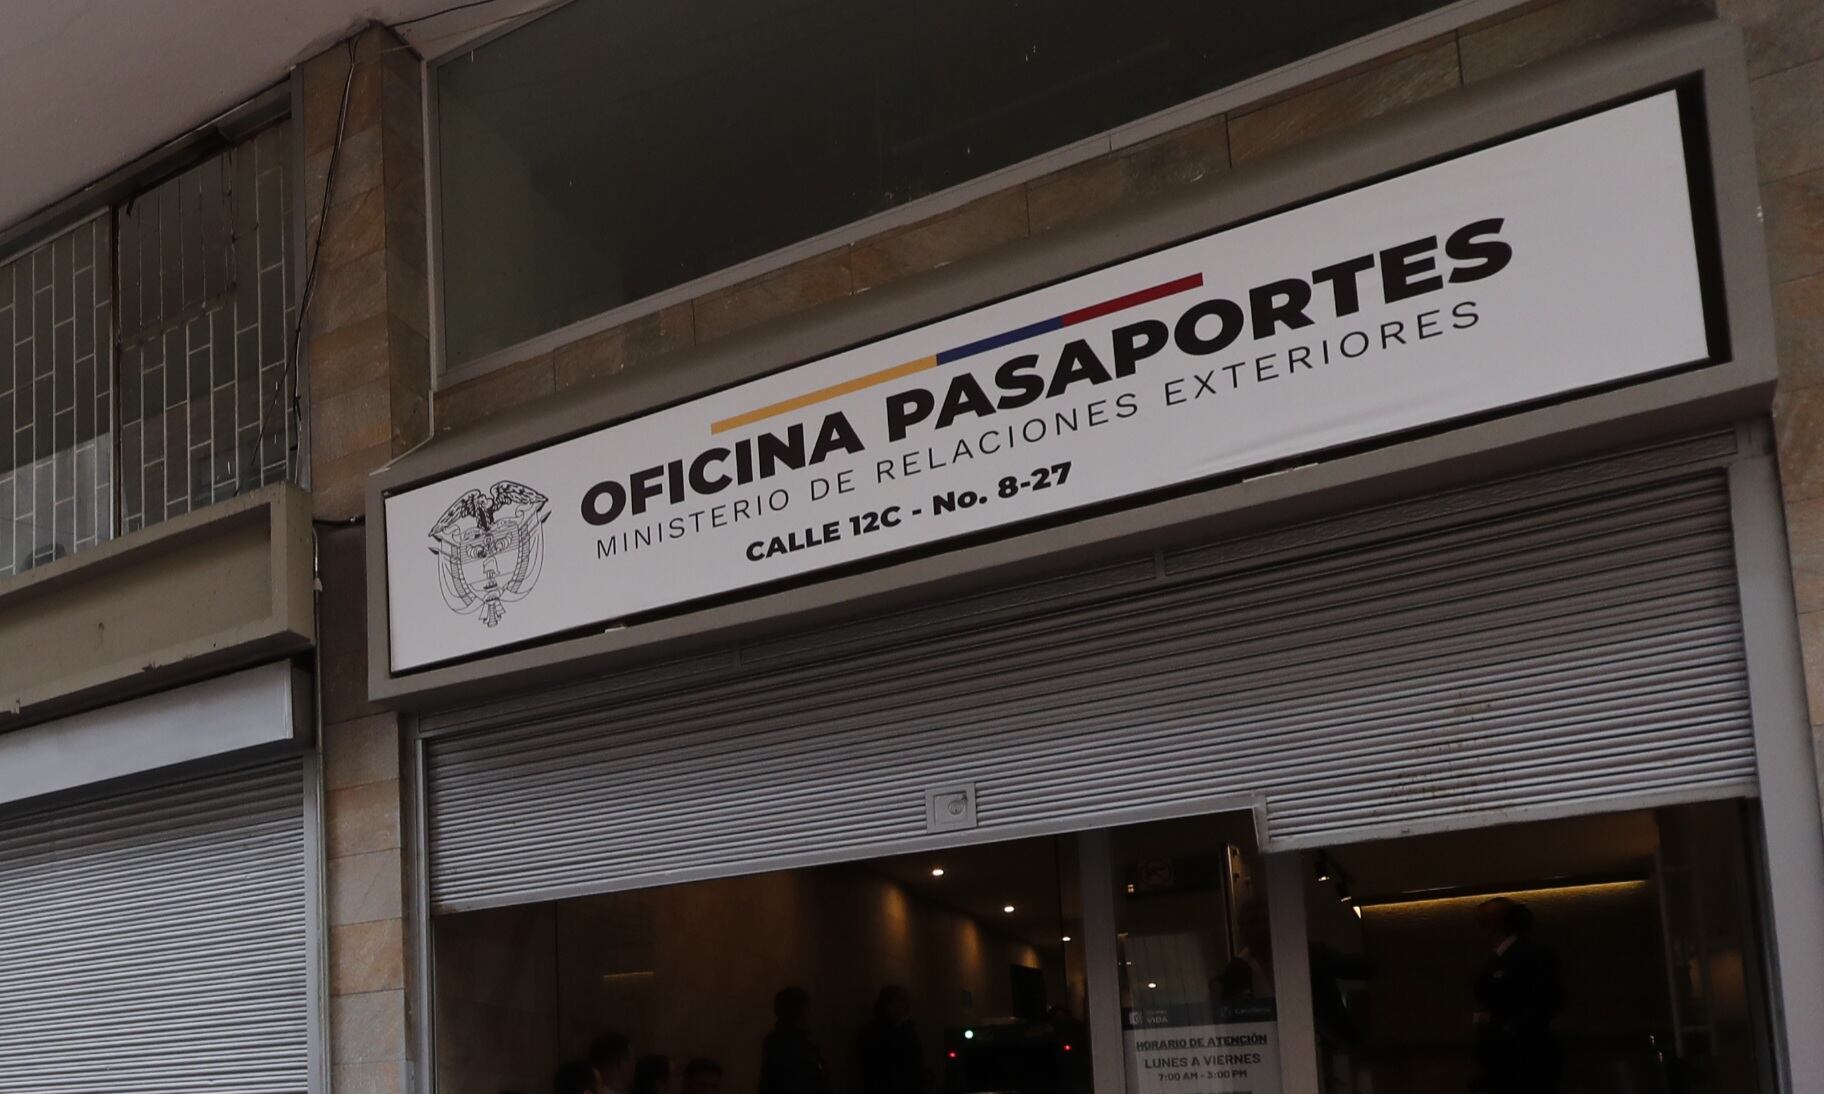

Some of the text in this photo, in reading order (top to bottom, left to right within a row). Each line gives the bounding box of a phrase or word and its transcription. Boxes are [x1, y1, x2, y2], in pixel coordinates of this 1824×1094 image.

[579, 217, 1513, 526] OFICINA PASAPORTES
[596, 301, 1479, 560] MINISTERIO DE RELACIONES EXTERIORES
[745, 520, 841, 562] CALLE
[848, 505, 902, 537] 12C
[932, 490, 988, 516] No.
[997, 461, 1072, 499] 8-27
[1146, 1016, 1168, 1024] VIDA
[1136, 1032, 1268, 1052] HORARIO DE ATENCIÓN
[1144, 1053, 1262, 1069] LUNES A VIERNES
[1158, 1072, 1181, 1081] 7:00
[1182, 1072, 1198, 1081] AM
[1207, 1070, 1230, 1080] 3:00
[1232, 1069, 1248, 1079] PM
